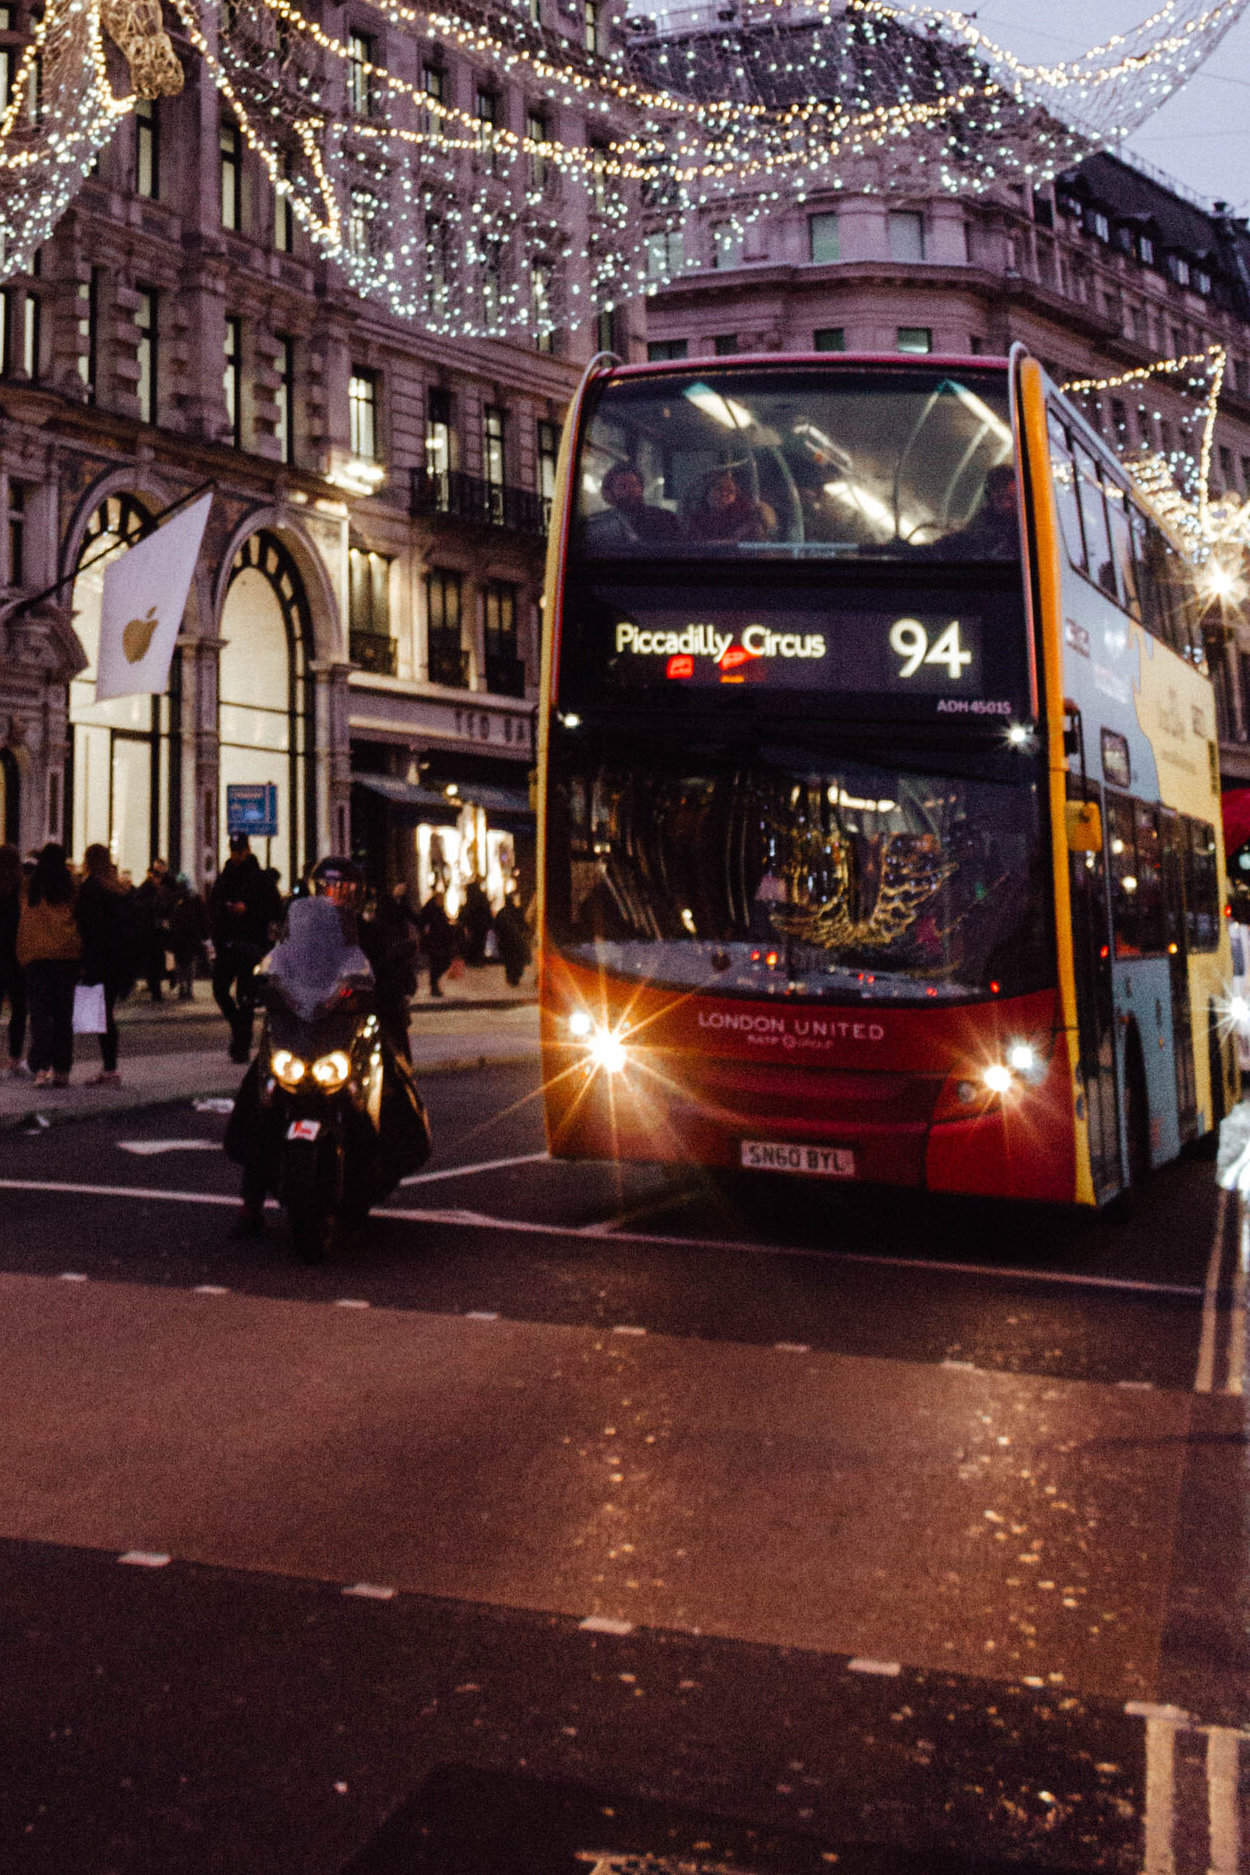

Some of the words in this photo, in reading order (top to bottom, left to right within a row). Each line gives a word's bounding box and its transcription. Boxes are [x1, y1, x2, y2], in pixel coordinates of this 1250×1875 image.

[616, 623, 734, 664] Piccadilly
[741, 624, 826, 658] Circus
[889, 618, 973, 679] 94
[937, 699, 969, 713] ADH
[504, 717, 527, 742] BA
[698, 1013, 785, 1033] LONDON
[794, 1019, 884, 1041] UNITED
[749, 1145, 801, 1168] SN60
